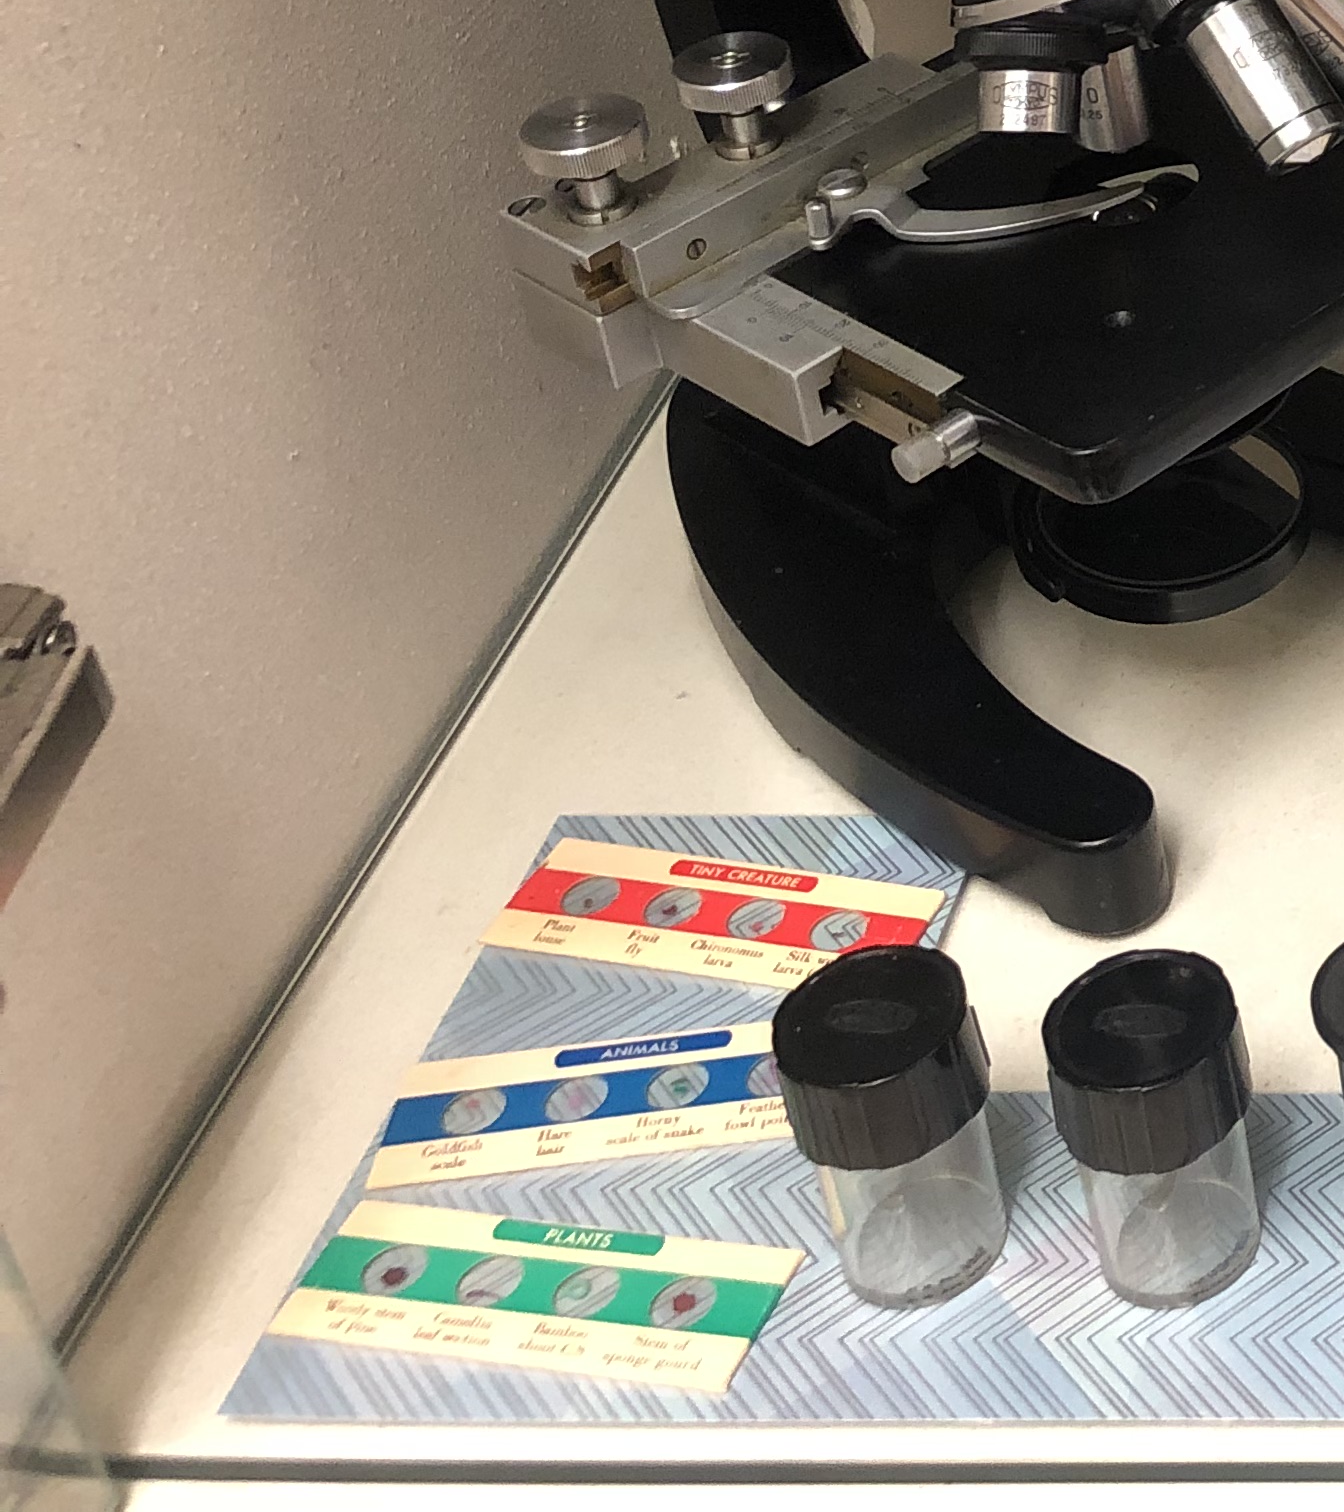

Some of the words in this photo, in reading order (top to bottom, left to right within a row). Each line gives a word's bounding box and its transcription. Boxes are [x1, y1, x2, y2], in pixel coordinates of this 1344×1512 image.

[690, 864, 726, 878] TINY
[726, 868, 803, 888] CREATURE
[543, 919, 576, 933] Plant
[627, 929, 660, 944] Fruit
[624, 943, 643, 959] fly
[690, 938, 765, 959] Chironomus
[703, 954, 734, 969] larva
[786, 950, 812, 964] Silk
[772, 962, 803, 976] larva
[600, 1039, 680, 1061] ANIMALS
[542, 1227, 614, 1249] PLANTS
